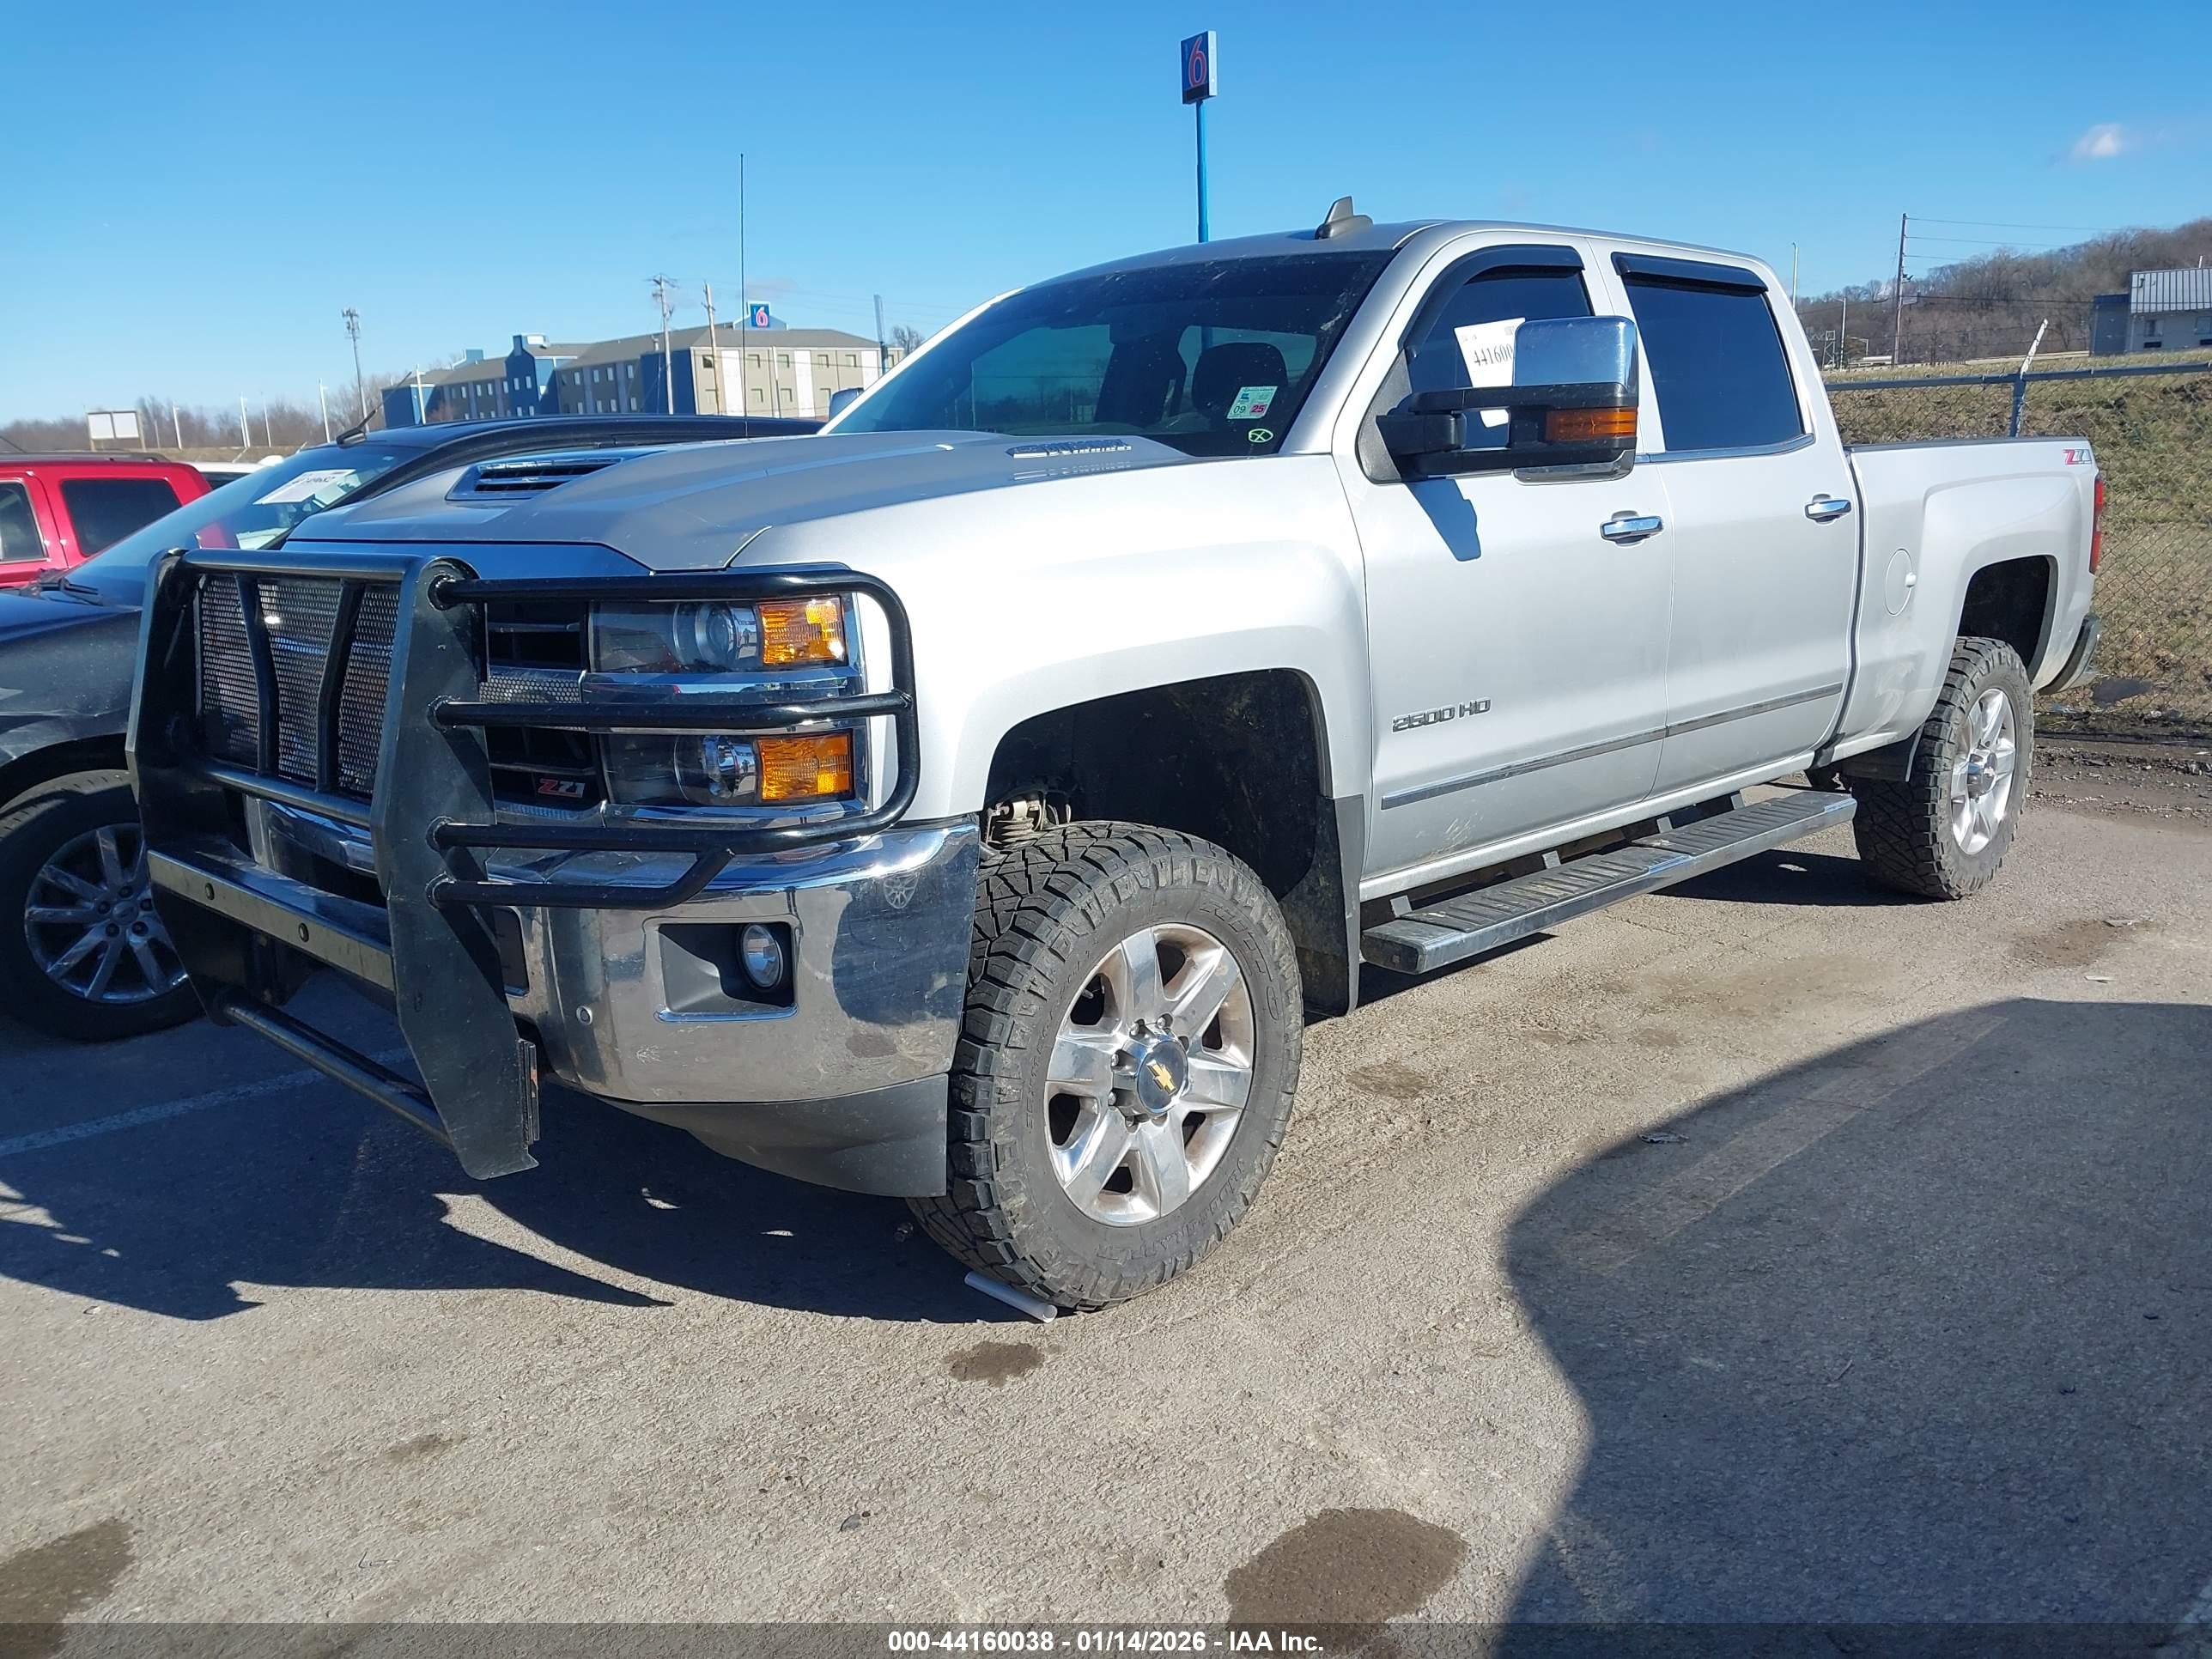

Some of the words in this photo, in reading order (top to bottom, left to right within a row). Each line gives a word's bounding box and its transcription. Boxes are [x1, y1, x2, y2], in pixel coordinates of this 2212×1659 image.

[1188, 35, 1206, 88] 6
[756, 307, 769, 327] 6
[1234, 405, 1246, 414] 09
[1251, 404, 1265, 413] 25
[2063, 448, 2093, 465] Z71
[1392, 706, 1455, 732] 2500
[1459, 698, 1492, 718] HD
[538, 778, 586, 798] Z71
